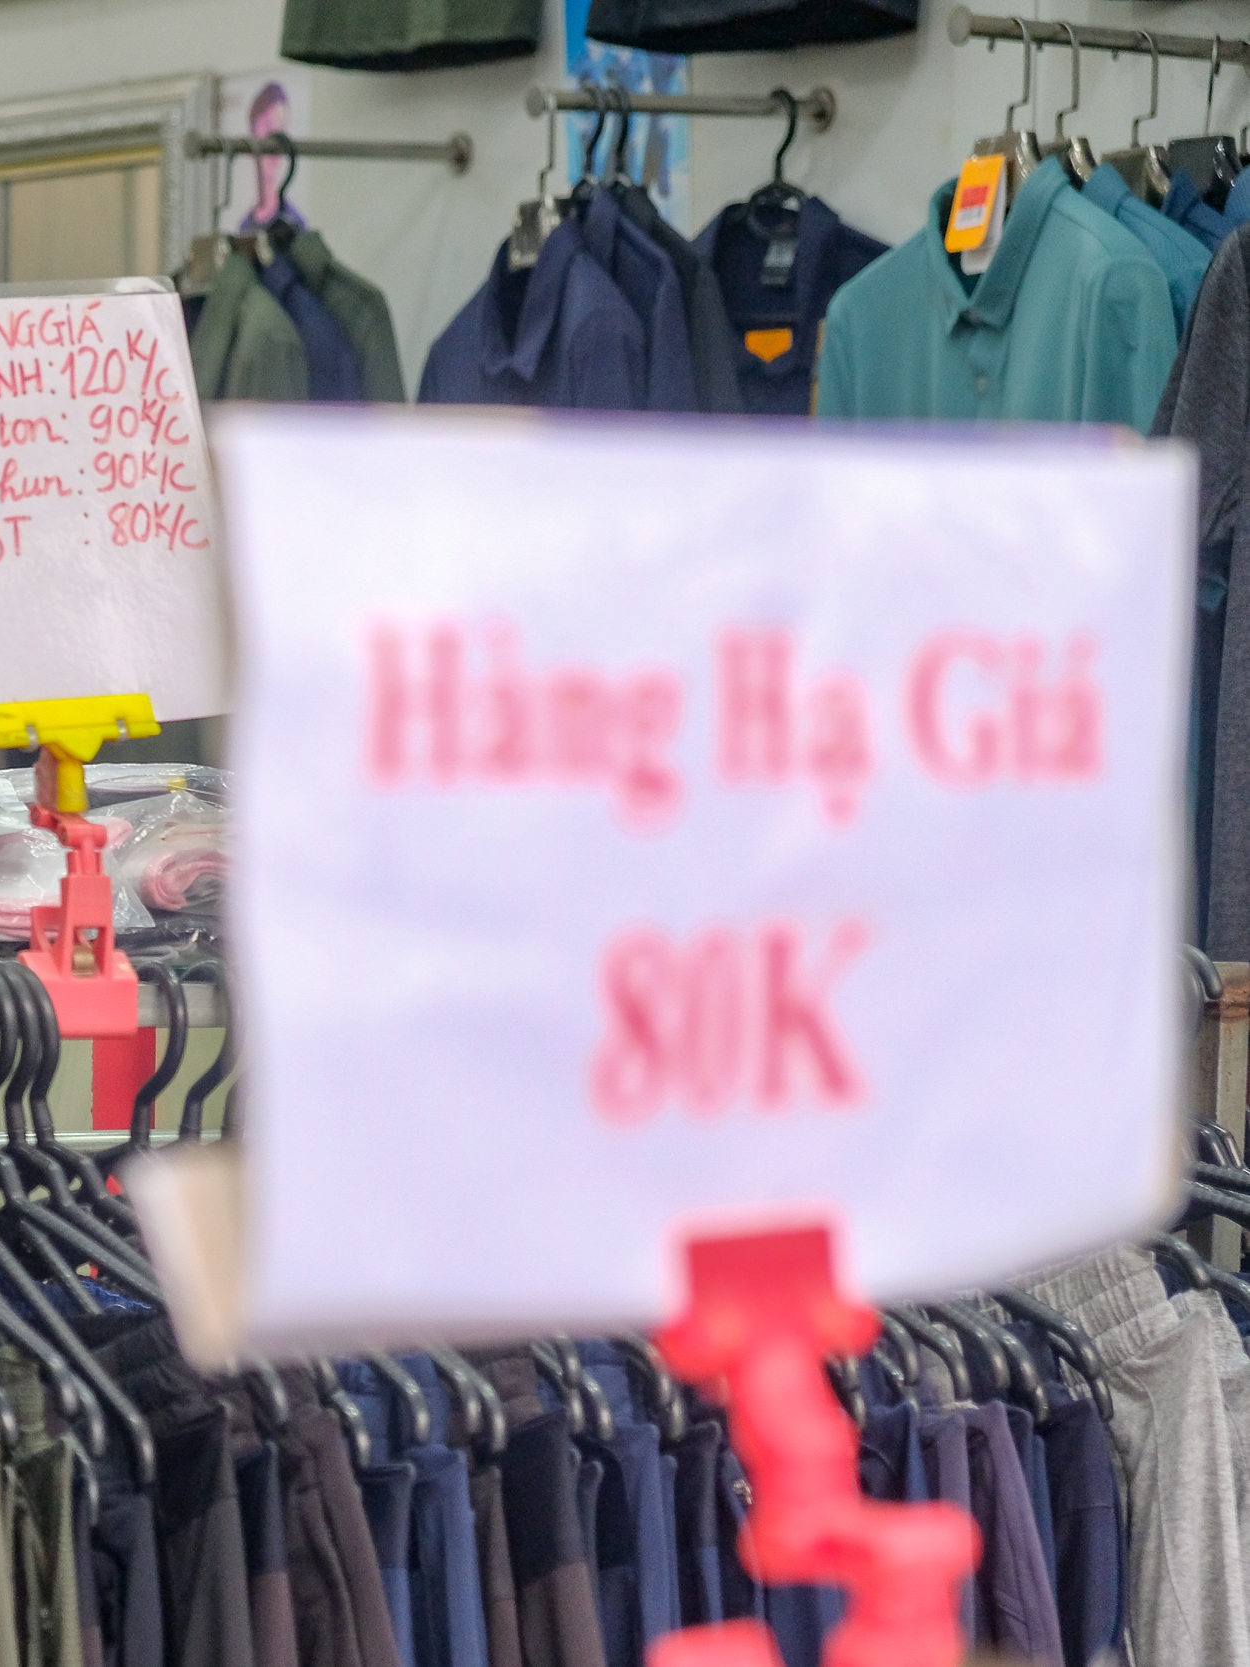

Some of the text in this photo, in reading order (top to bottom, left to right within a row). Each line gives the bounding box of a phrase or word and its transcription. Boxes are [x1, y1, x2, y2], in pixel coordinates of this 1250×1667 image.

[362, 618, 1102, 830] Hàng Hạ Giá
[591, 918, 876, 1130] 80K
